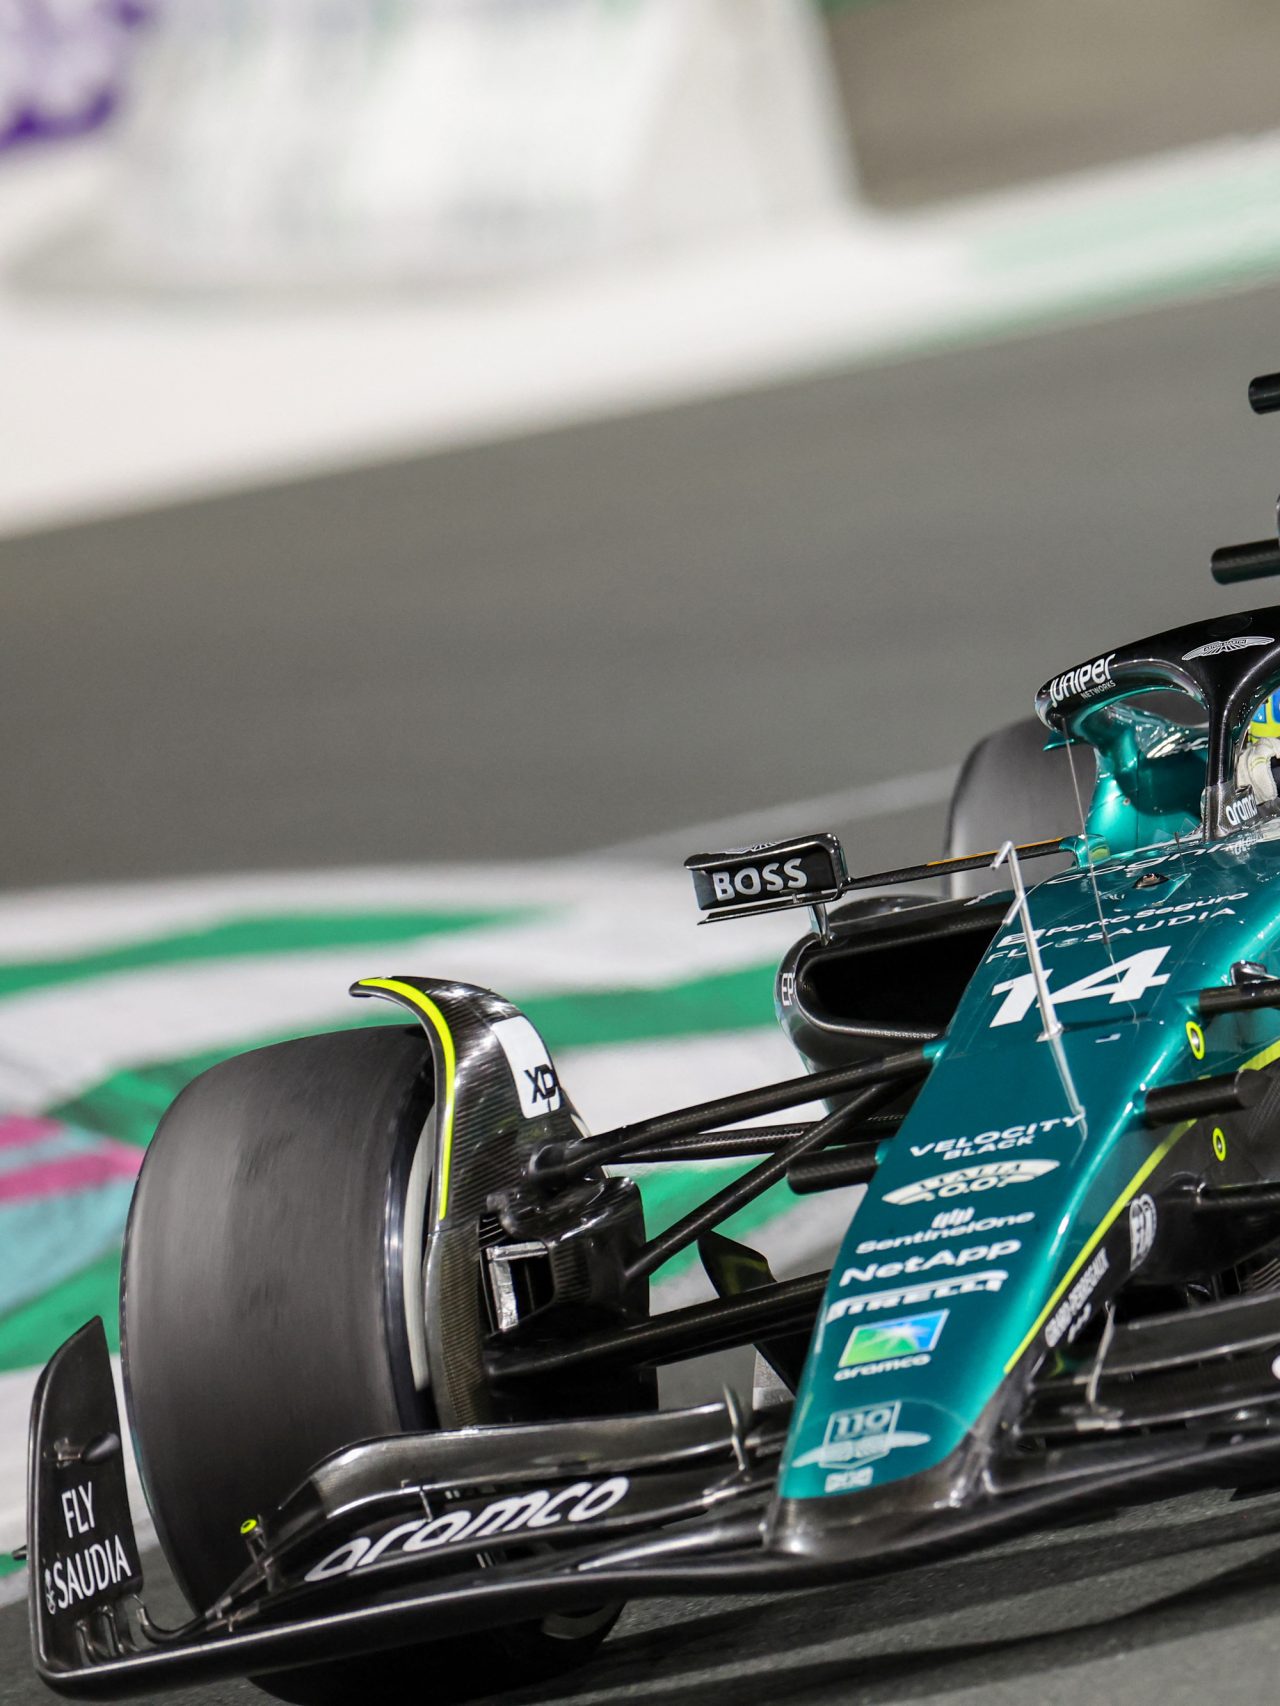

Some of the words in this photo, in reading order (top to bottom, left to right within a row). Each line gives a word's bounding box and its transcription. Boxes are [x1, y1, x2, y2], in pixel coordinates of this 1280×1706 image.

[1080, 679, 1117, 700] NETWORKS
[712, 857, 808, 902] BOSS
[1046, 914, 1131, 937] Porto
[1133, 892, 1249, 919] Seguro
[1083, 906, 1236, 943] SAUDIA
[989, 945, 1172, 1028] 14
[910, 1114, 1085, 1158] VELOCITY
[943, 1134, 1036, 1161] BLACK
[854, 1211, 1036, 1254] SentinelOne
[838, 1239, 1022, 1287] NetApp
[826, 1269, 1009, 1324] PIRELLI
[833, 1353, 932, 1382] aramco
[61, 1480, 95, 1539] FLY
[304, 1476, 629, 1582] aramco
[53, 1534, 132, 1610] SAUDIA
